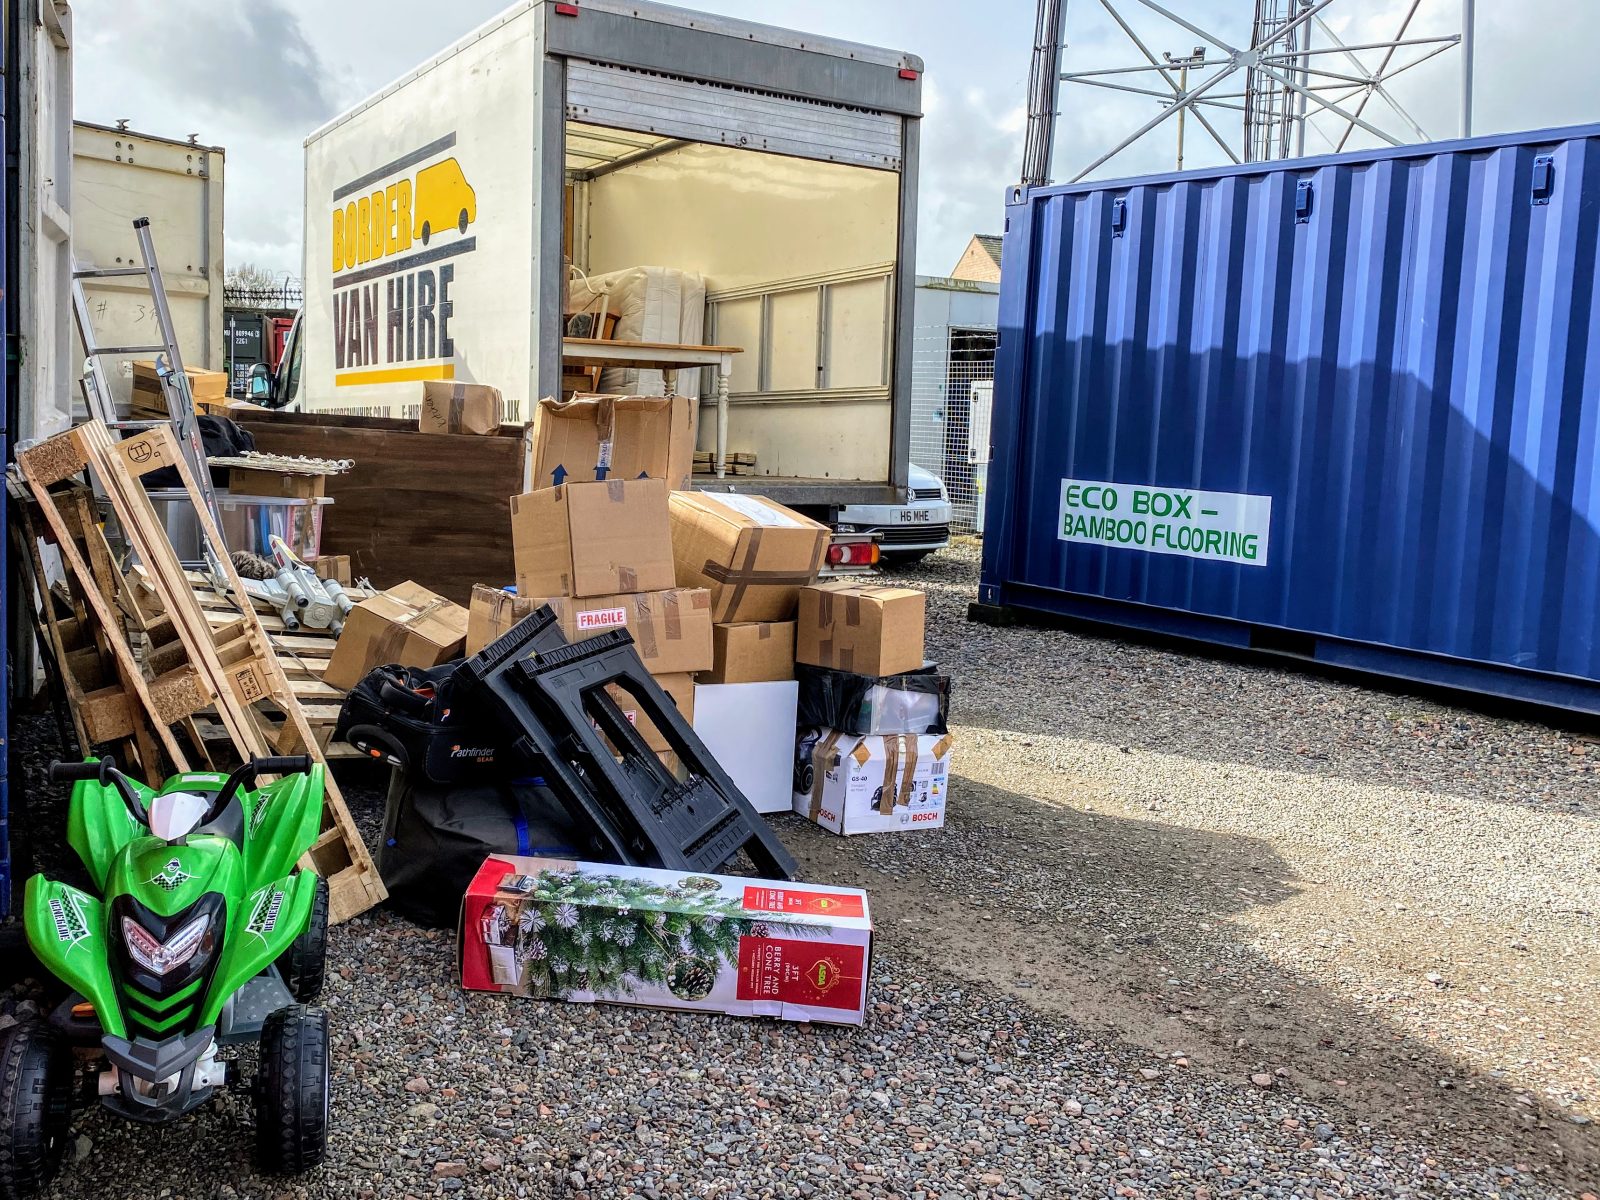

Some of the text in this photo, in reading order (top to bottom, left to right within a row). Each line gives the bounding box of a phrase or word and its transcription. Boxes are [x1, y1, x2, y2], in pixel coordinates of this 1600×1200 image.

[333, 178, 412, 273] BORDER
[333, 263, 454, 369] VAN HIRE
[901, 510, 929, 522] H6 MHE
[1066, 485, 1118, 511] ECO
[1132, 490, 1193, 519] BOX
[1063, 513, 1258, 559] BAMBOO FLOORING
[580, 611, 624, 626] FRAGILE
[450, 745, 495, 757] Pathfinder
[912, 812, 938, 822] BOSCH
[49, 900, 70, 940] RENEGADE
[263, 892, 284, 931] RENEGADE
[763, 945, 774, 994] CONE TREE
[771, 946, 782, 995] BERRY AND
[791, 965, 799, 981] 3FT
[817, 964, 827, 986] ASDA
